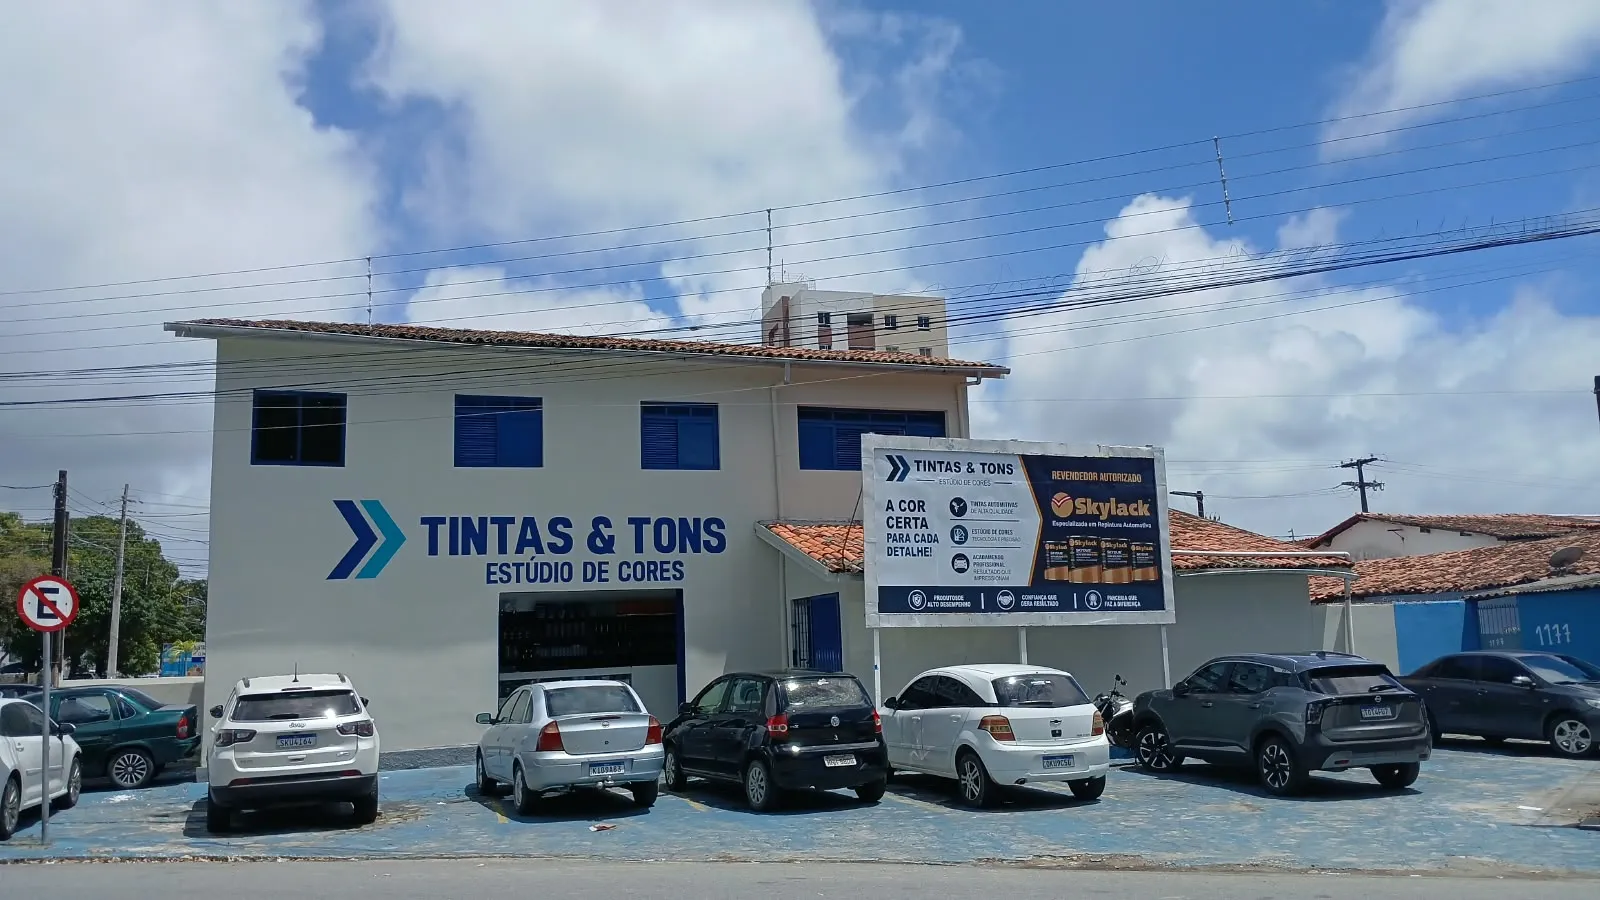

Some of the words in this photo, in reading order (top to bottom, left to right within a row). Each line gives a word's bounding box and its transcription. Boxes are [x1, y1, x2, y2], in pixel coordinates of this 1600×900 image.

[914, 459, 962, 474] TINTAS
[966, 461, 976, 474] &
[980, 462, 1014, 476] TONS
[939, 477, 963, 486] ESTÚDIO
[972, 479, 992, 487] CORES
[1051, 470, 1098, 481] REVENDEDOR
[1099, 472, 1142, 483] AUTORIZADO
[885, 499, 895, 512] A
[898, 499, 926, 513] COR
[1074, 497, 1151, 520] Skylack
[886, 516, 929, 529] CERTA
[1052, 520, 1088, 528] Especializada
[420, 515, 574, 557] TINTAS
[586, 515, 616, 555] &
[628, 517, 727, 555] TONS
[886, 532, 911, 543] PARA
[914, 533, 939, 544] CADA
[887, 546, 932, 557] DETALHE!
[486, 556, 574, 584] ESTÚDIO
[582, 561, 610, 583] DE
[618, 560, 685, 582] CORES
[37, 587, 60, 620] E
[1535, 623, 1571, 646] 1177
